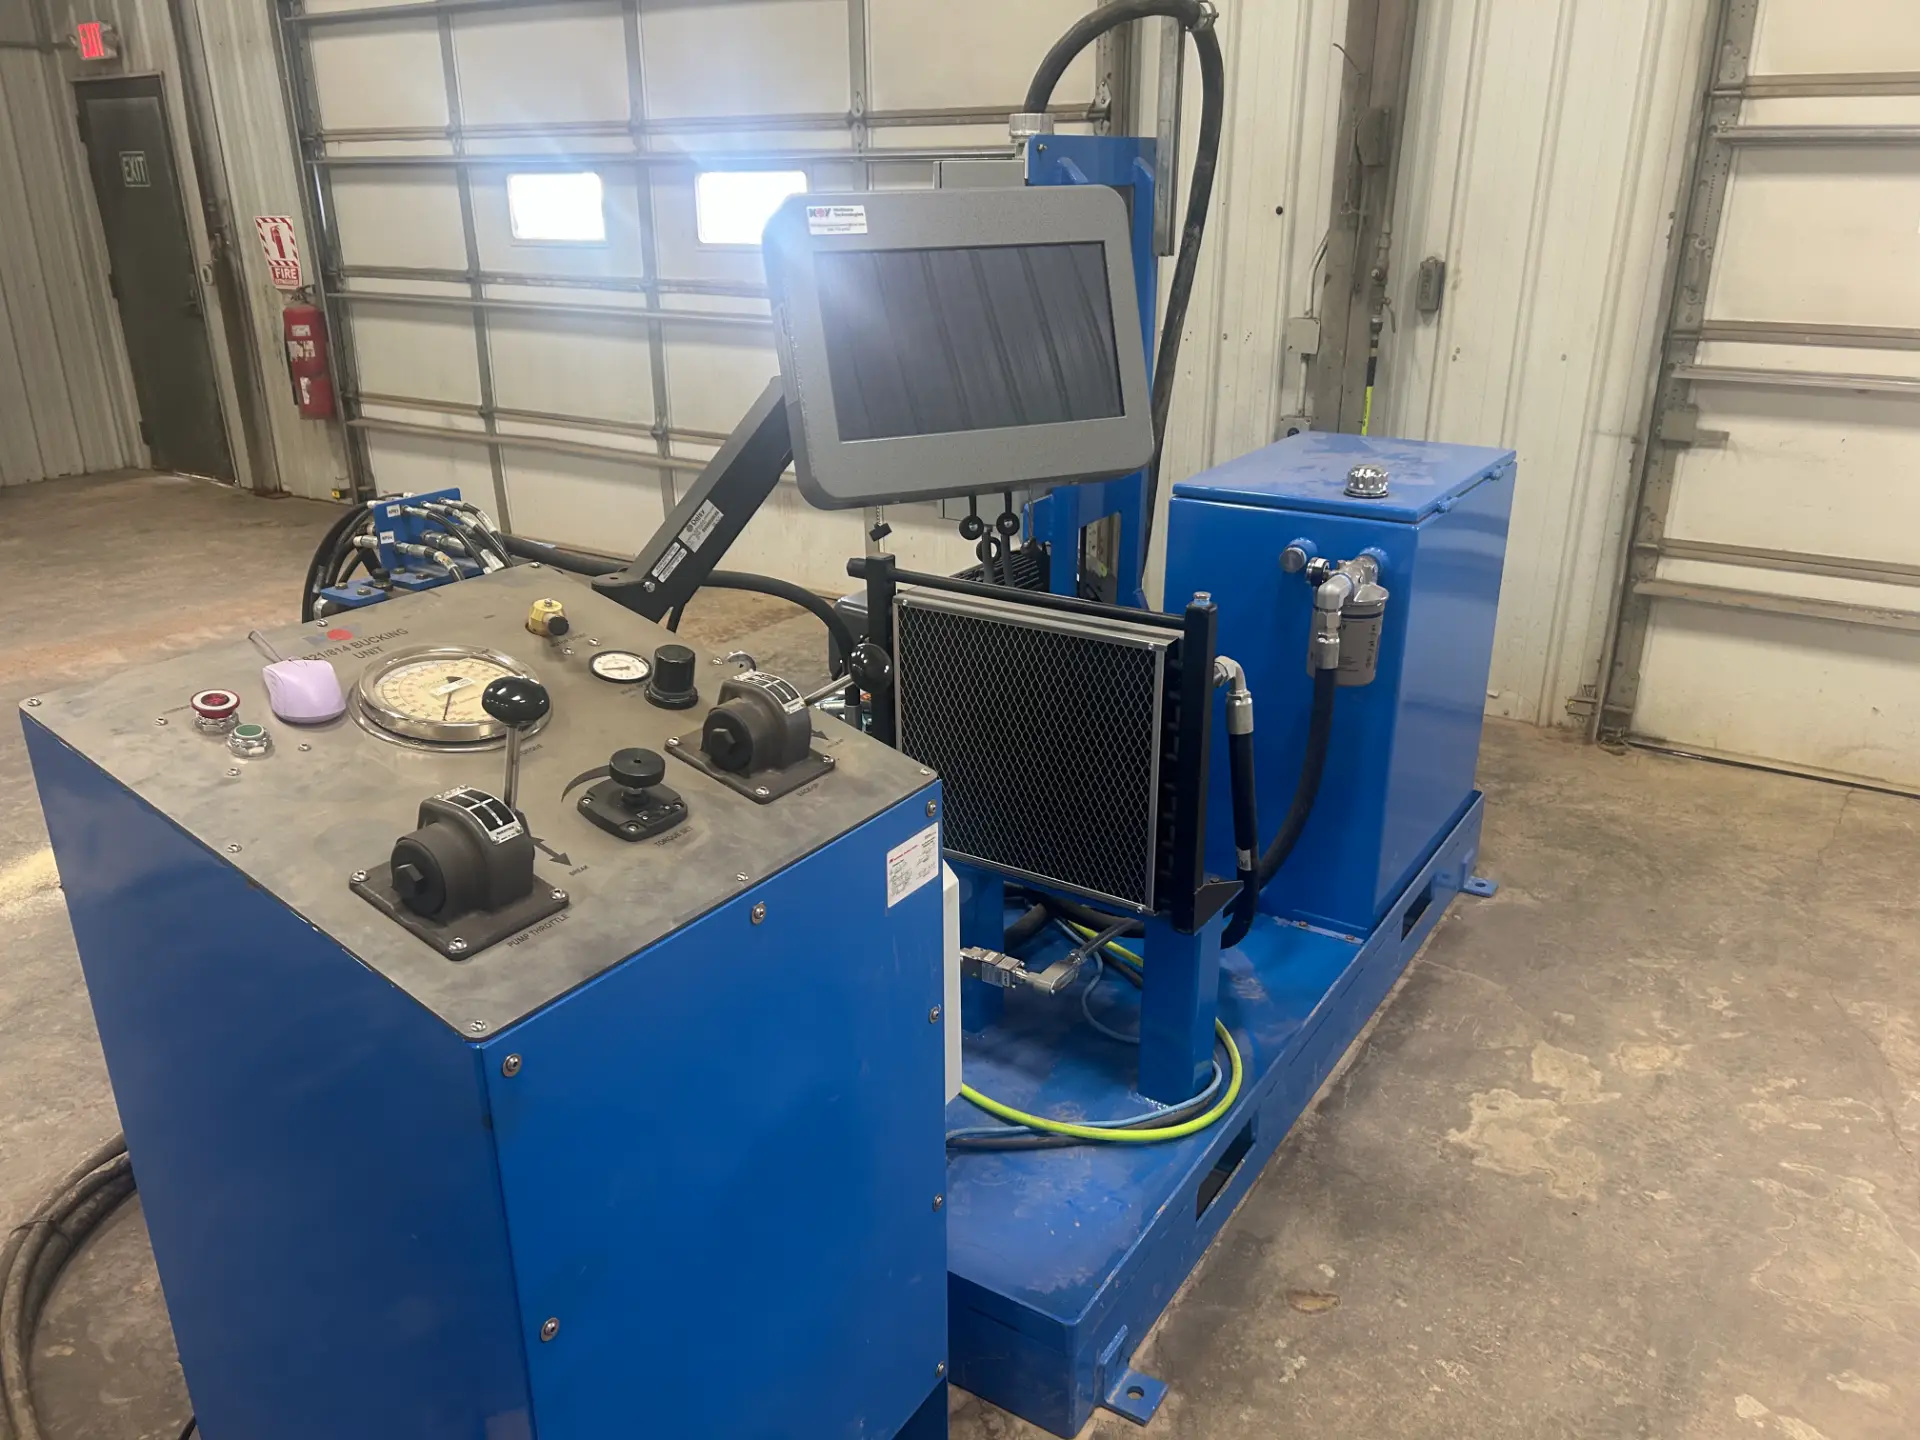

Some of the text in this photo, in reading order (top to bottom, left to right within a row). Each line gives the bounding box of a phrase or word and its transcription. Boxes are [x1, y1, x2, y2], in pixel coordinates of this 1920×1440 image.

[78, 23, 104, 58] EXIT
[122, 156, 146, 182] EXIT
[274, 267, 298, 280] FIRE
[349, 627, 409, 649] BUCKING
[352, 645, 384, 659] UNIT
[507, 912, 571, 949] PUMP THROTTLE
